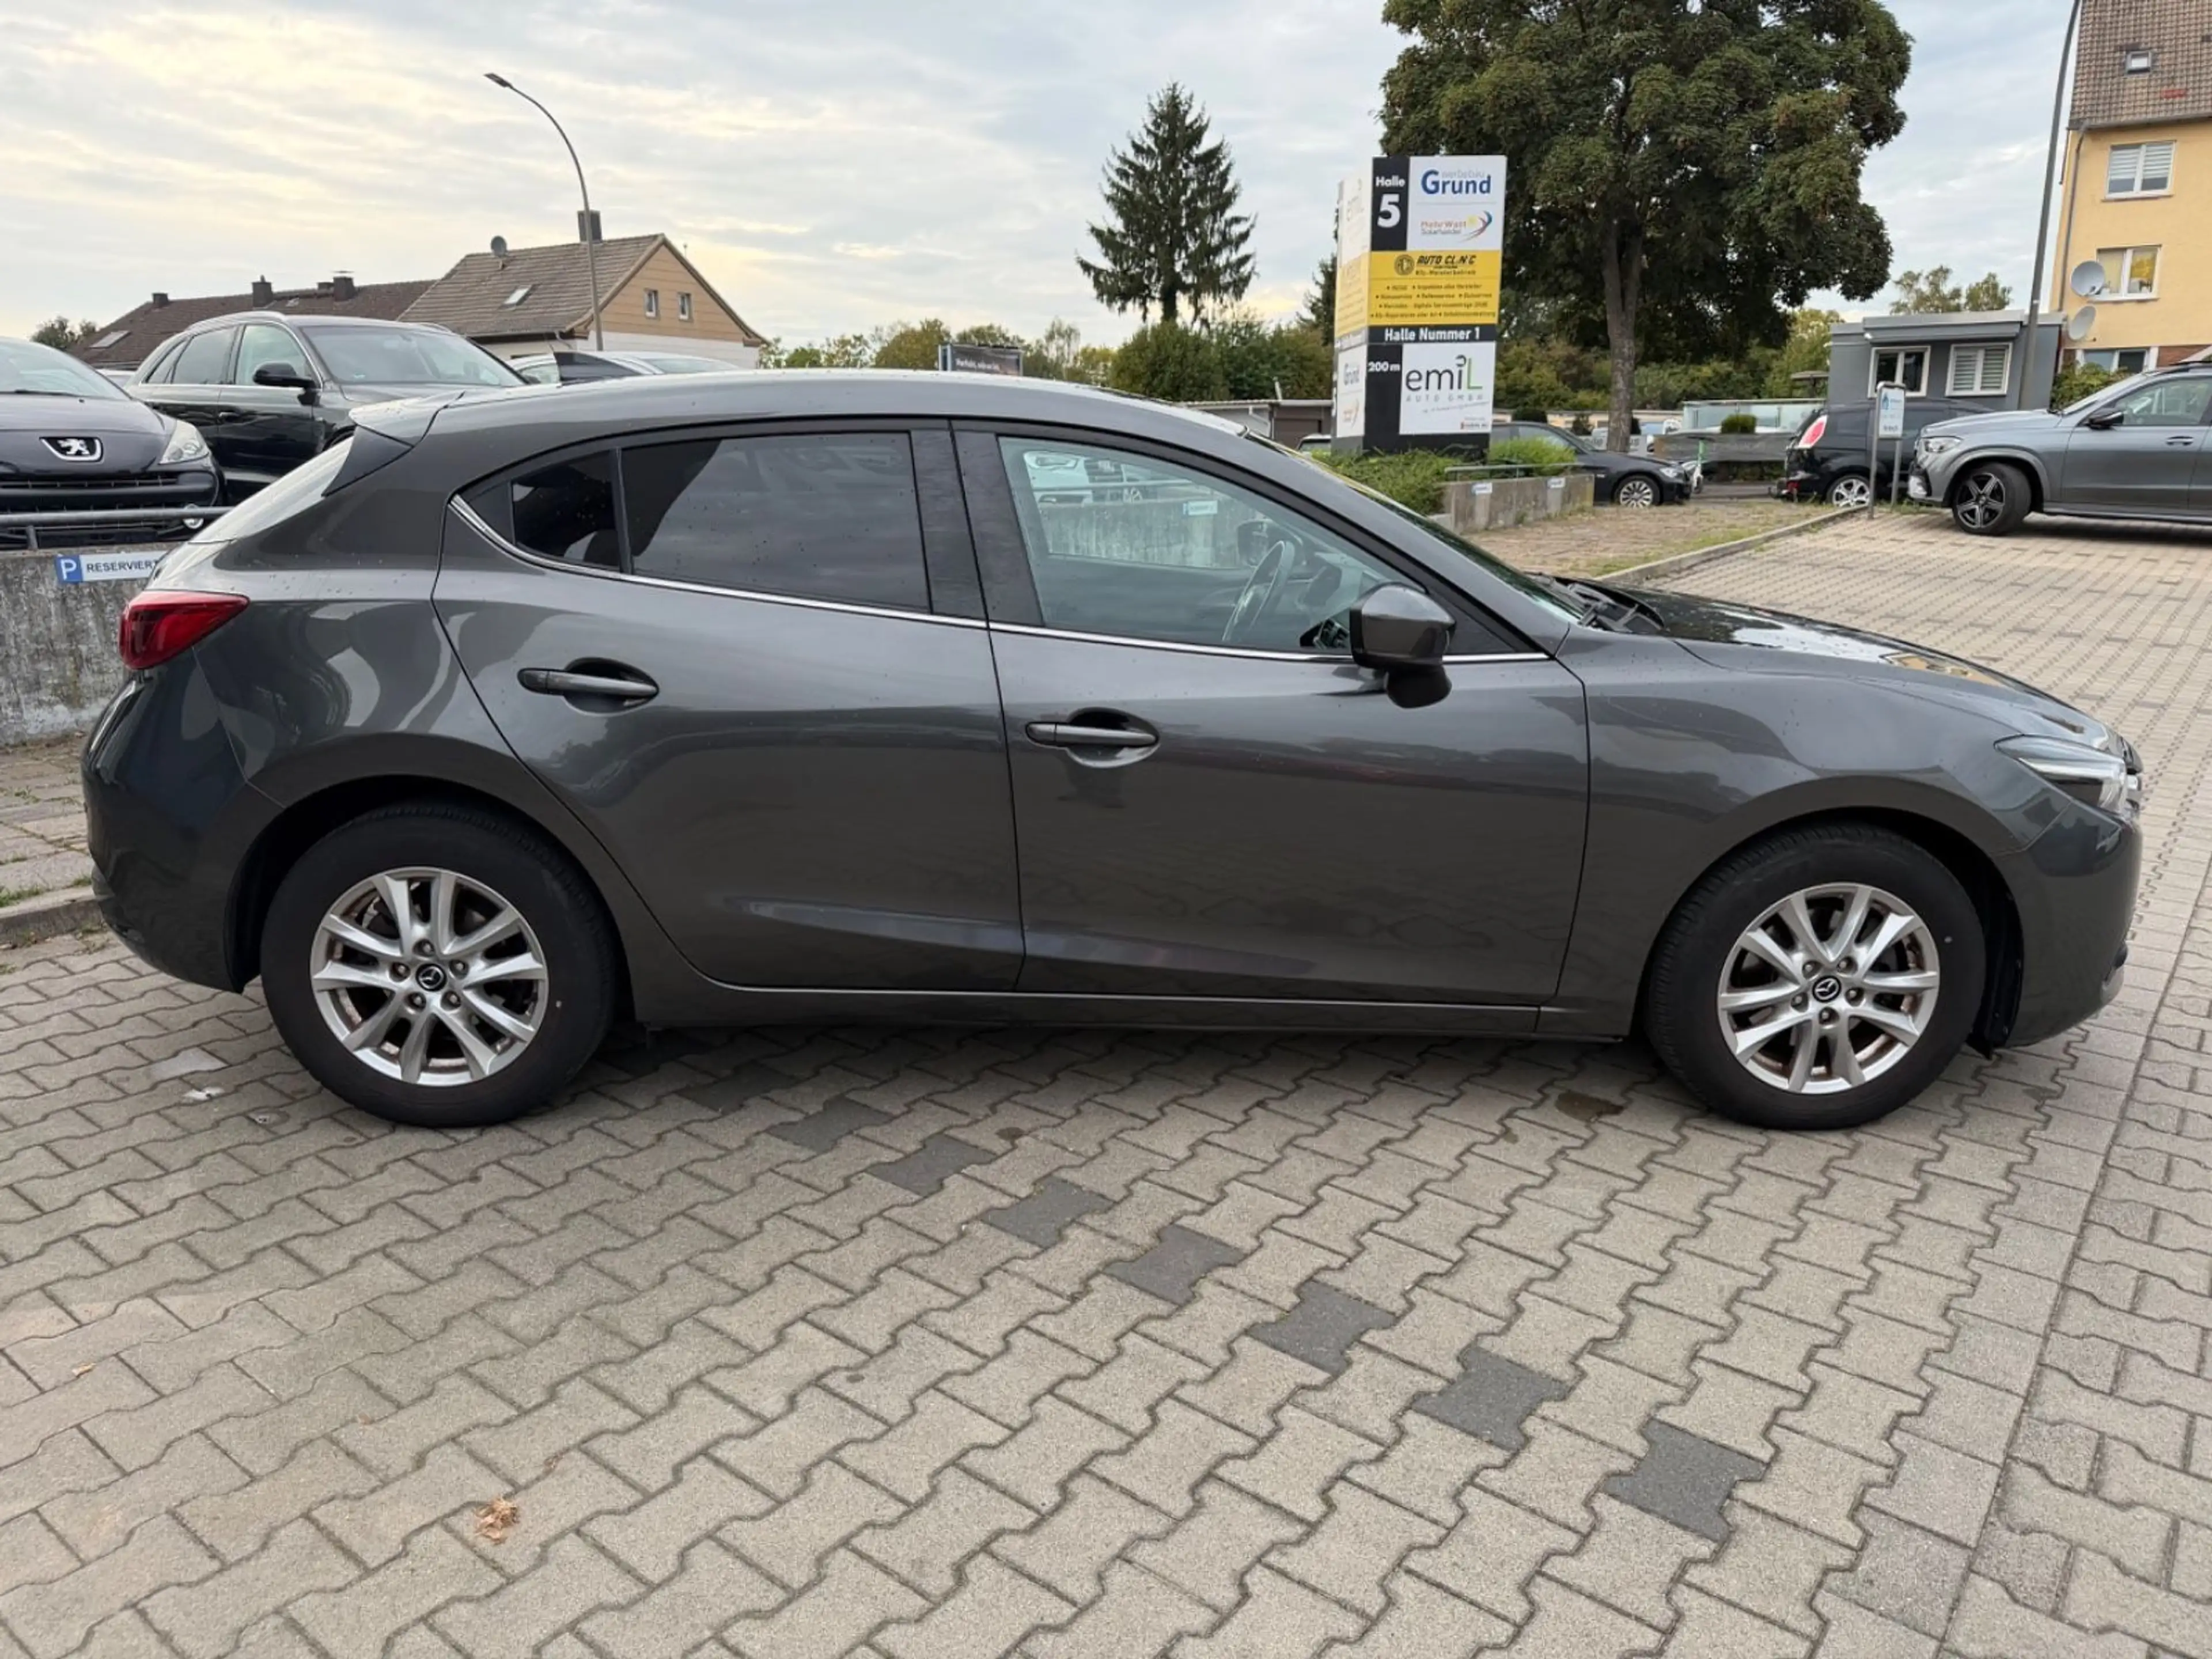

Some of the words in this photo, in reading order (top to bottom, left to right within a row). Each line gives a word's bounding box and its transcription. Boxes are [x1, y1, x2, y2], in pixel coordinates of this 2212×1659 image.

[1376, 175, 1406, 188] Halle
[1421, 169, 1491, 194] Grund
[1377, 194, 1400, 228] 5
[1384, 328, 1415, 342] Halle
[1419, 327, 1471, 341] Nummer
[1474, 327, 1480, 339] 1
[1367, 361, 1389, 372] 200
[1389, 363, 1400, 372] m
[1406, 394, 1440, 403] AUTO
[60, 558, 77, 581] P
